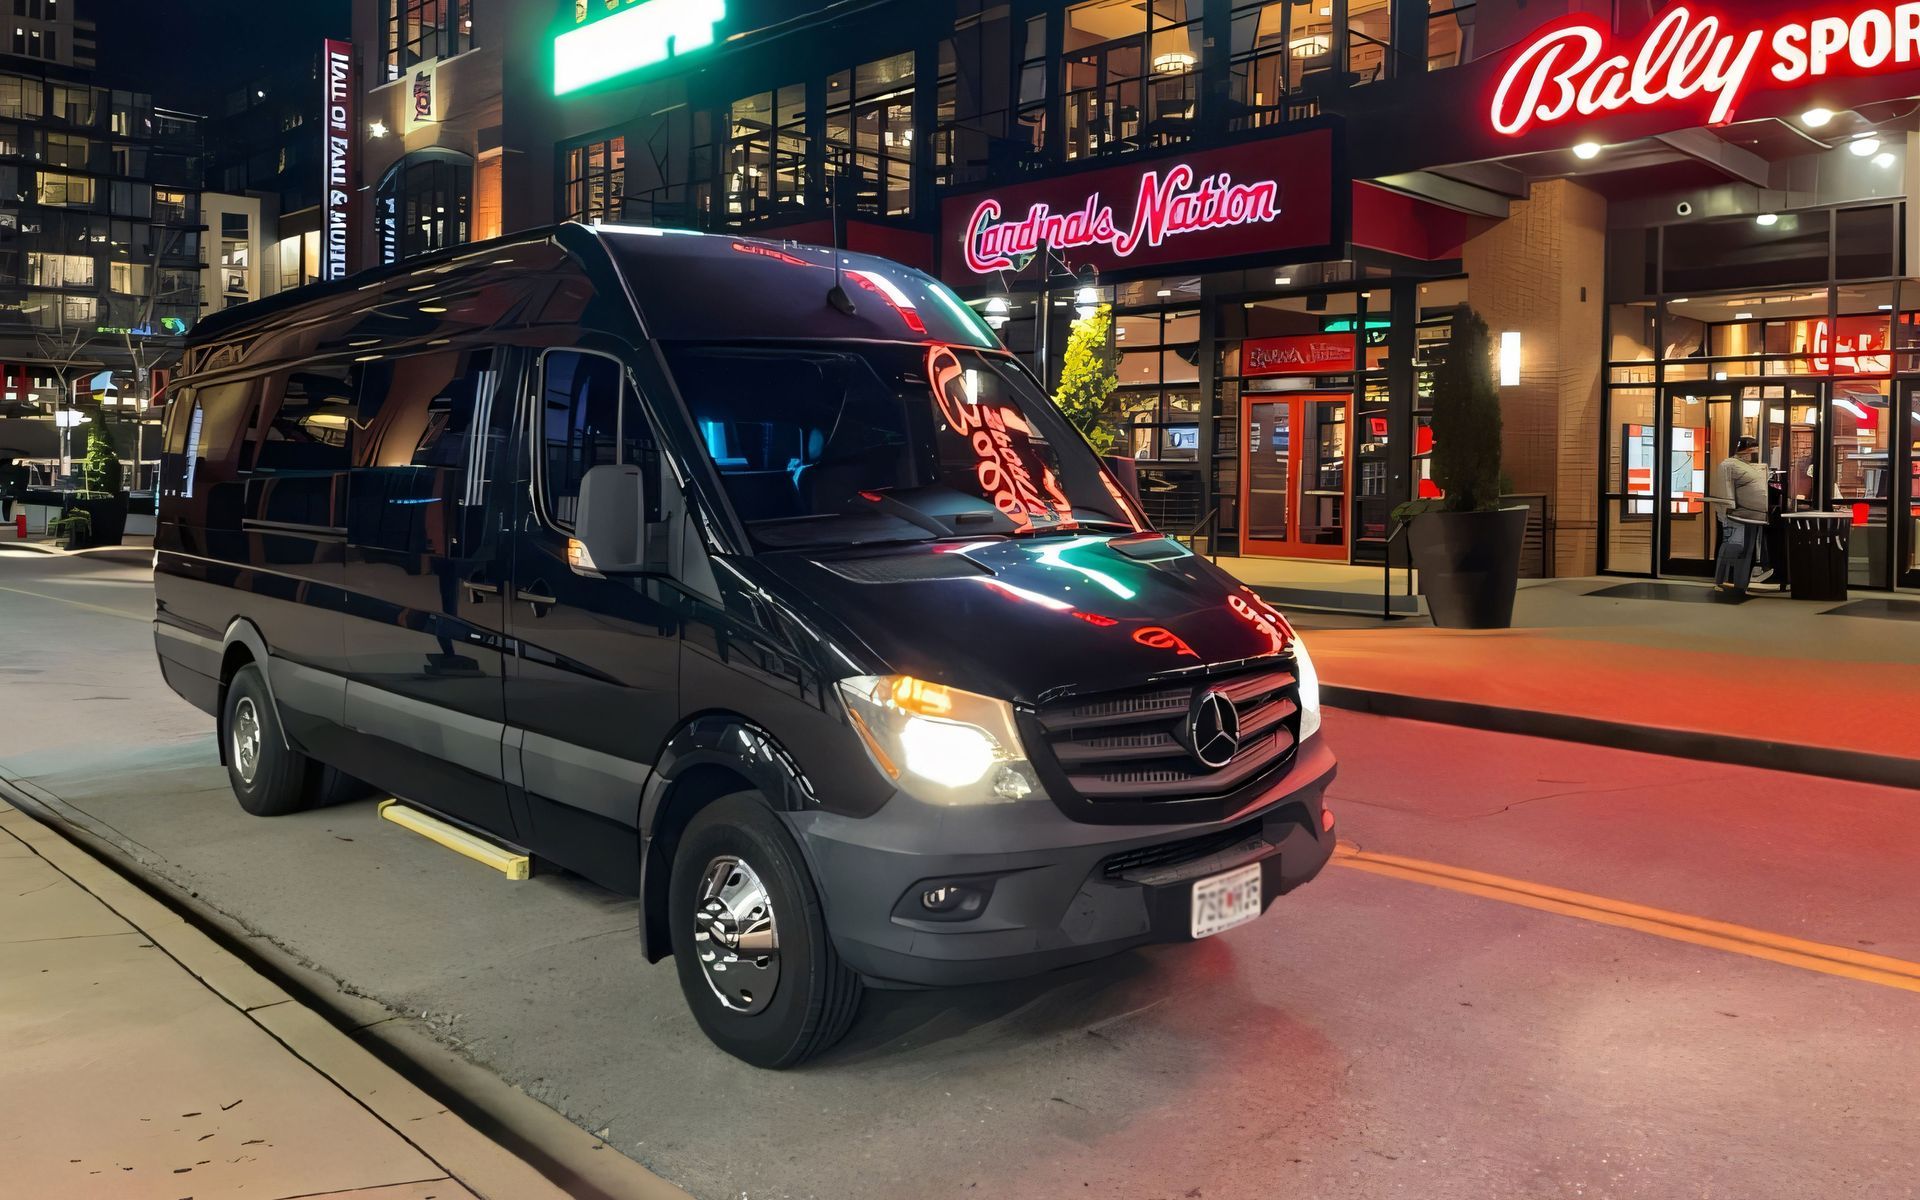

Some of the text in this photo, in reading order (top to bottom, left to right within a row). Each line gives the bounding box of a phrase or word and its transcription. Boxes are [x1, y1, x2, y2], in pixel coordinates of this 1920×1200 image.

[1490, 5, 1764, 135] Bally
[963, 163, 1282, 274] Cardinals Nation
